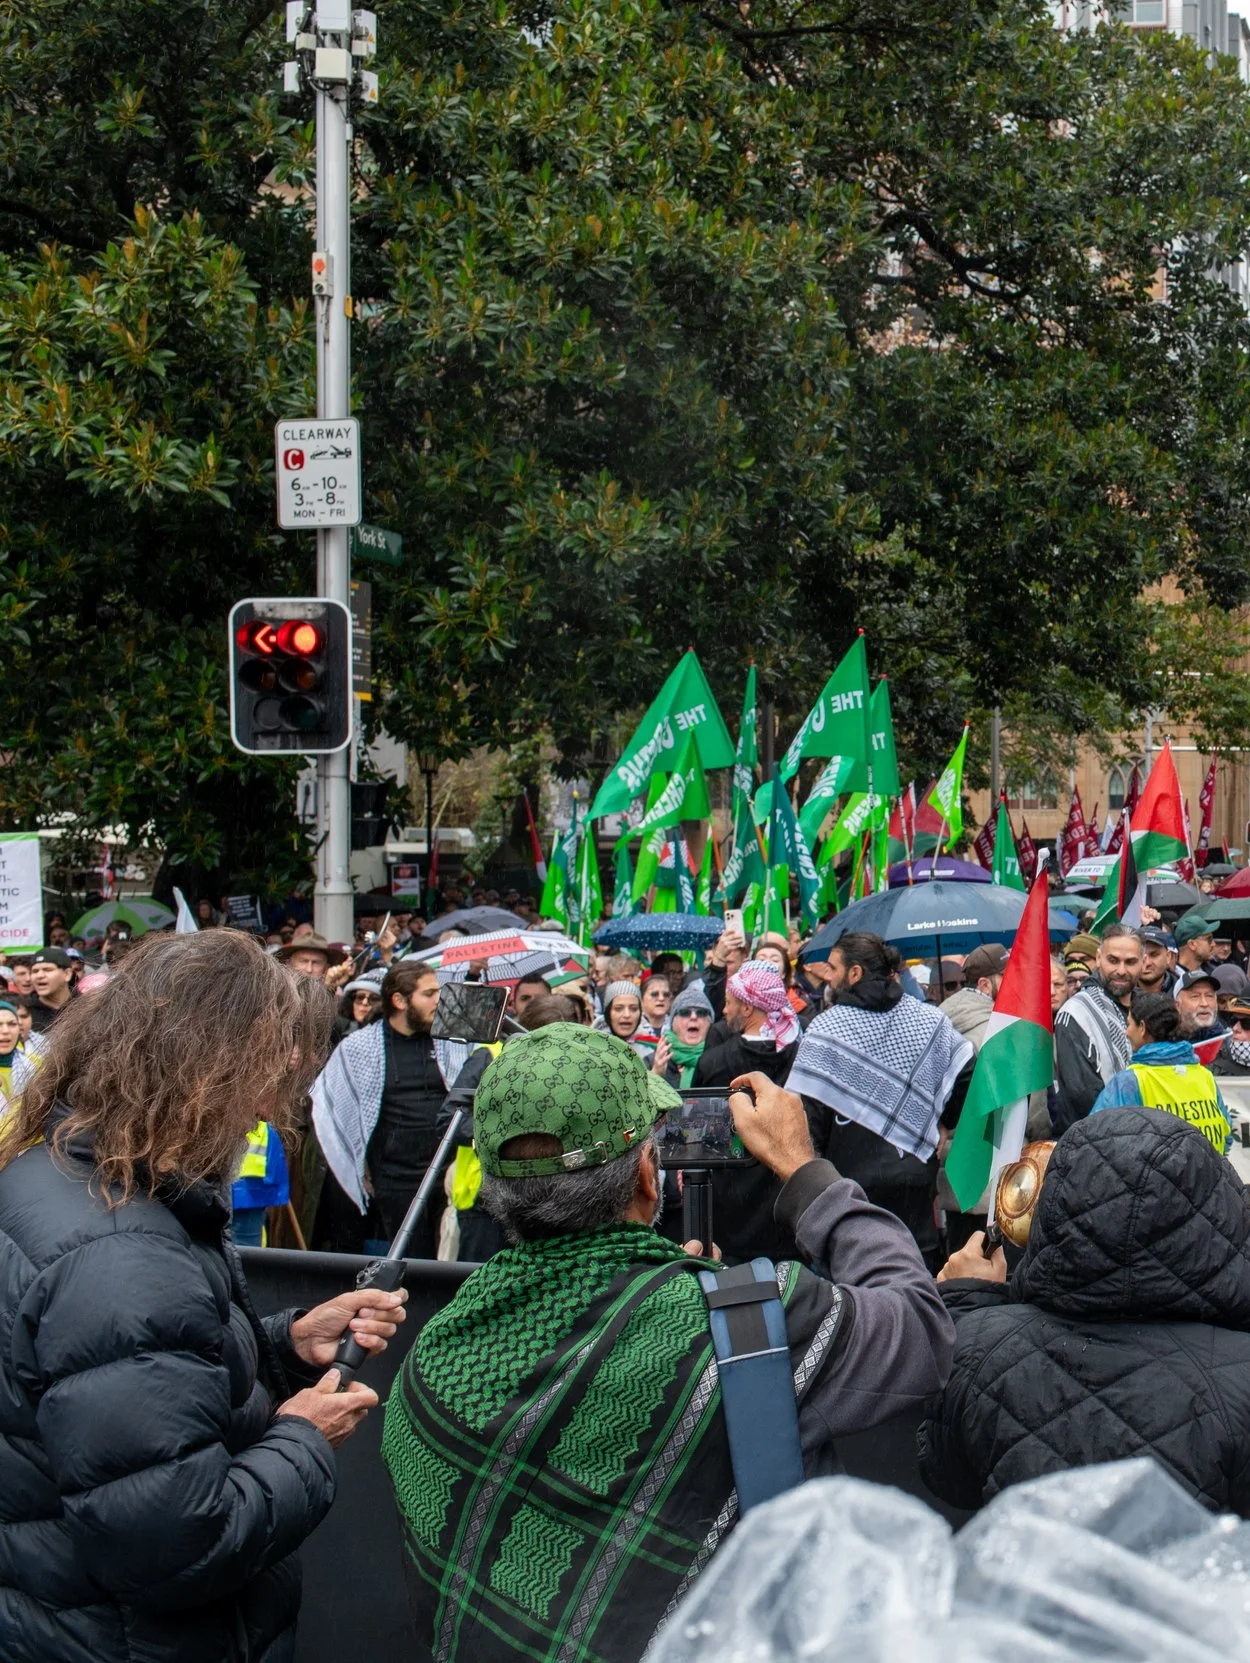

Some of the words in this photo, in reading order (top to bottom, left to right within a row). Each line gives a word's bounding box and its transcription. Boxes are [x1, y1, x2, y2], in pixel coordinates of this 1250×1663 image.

[283, 427, 352, 441] CLEARWAY
[287, 450, 300, 470] C
[293, 509, 315, 519] MON
[329, 508, 346, 518] FRI
[358, 526, 377, 547] York
[377, 530, 386, 550] St
[907, 921, 936, 931] Larke
[937, 918, 979, 928] Hoskins
[445, 941, 520, 960] PALESTINE
[1156, 1099, 1222, 1121] PALESTIN
